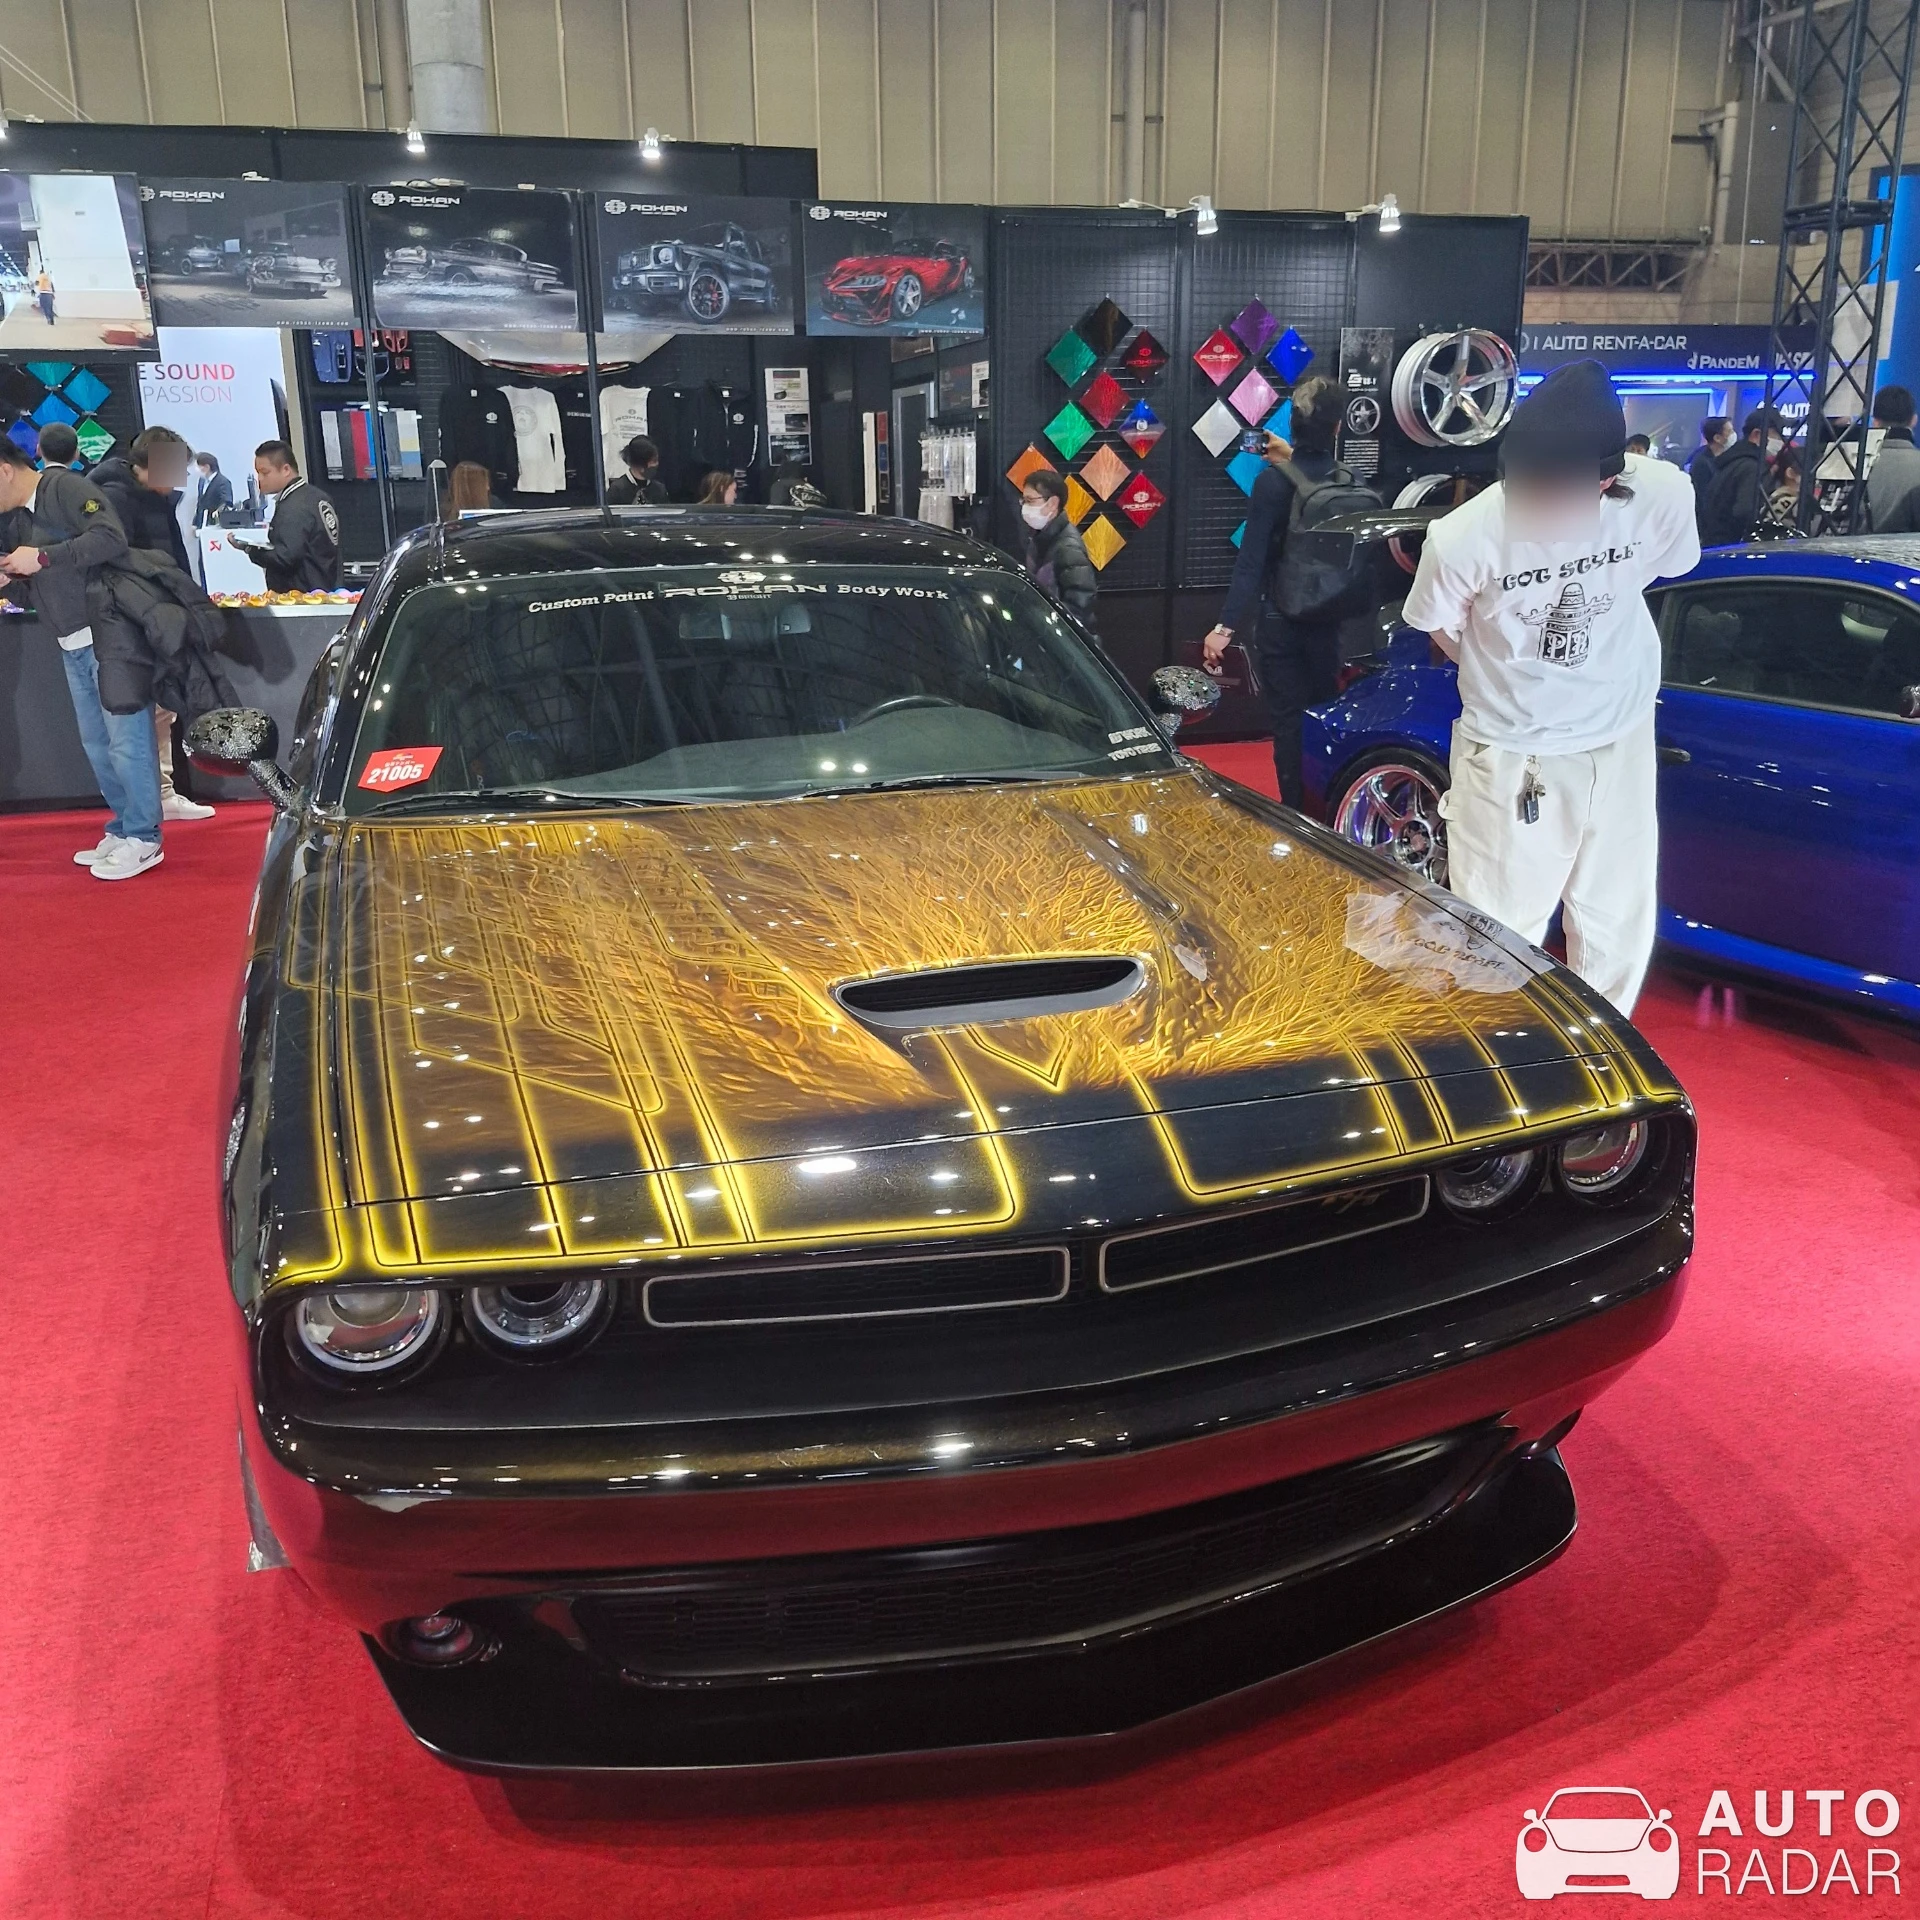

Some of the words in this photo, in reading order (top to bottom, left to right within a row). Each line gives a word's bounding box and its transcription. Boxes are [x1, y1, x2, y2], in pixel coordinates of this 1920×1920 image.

[159, 190, 225, 199] ROHAN
[398, 195, 461, 204] ROHAN
[629, 204, 688, 213] ROHAN
[833, 210, 888, 218] ROHAN
[1542, 336, 1588, 350] AUTO
[1592, 336, 1687, 350] RENT-A-CAR
[1700, 355, 1760, 369] PANDEM
[154, 363, 235, 380] SOUND
[143, 385, 232, 403] PASSION
[528, 595, 600, 613] Custom
[603, 590, 655, 604] Paint
[664, 584, 827, 598] ROHAN
[837, 584, 891, 597] Body
[894, 586, 950, 600] Work
[366, 764, 425, 785] 21005
